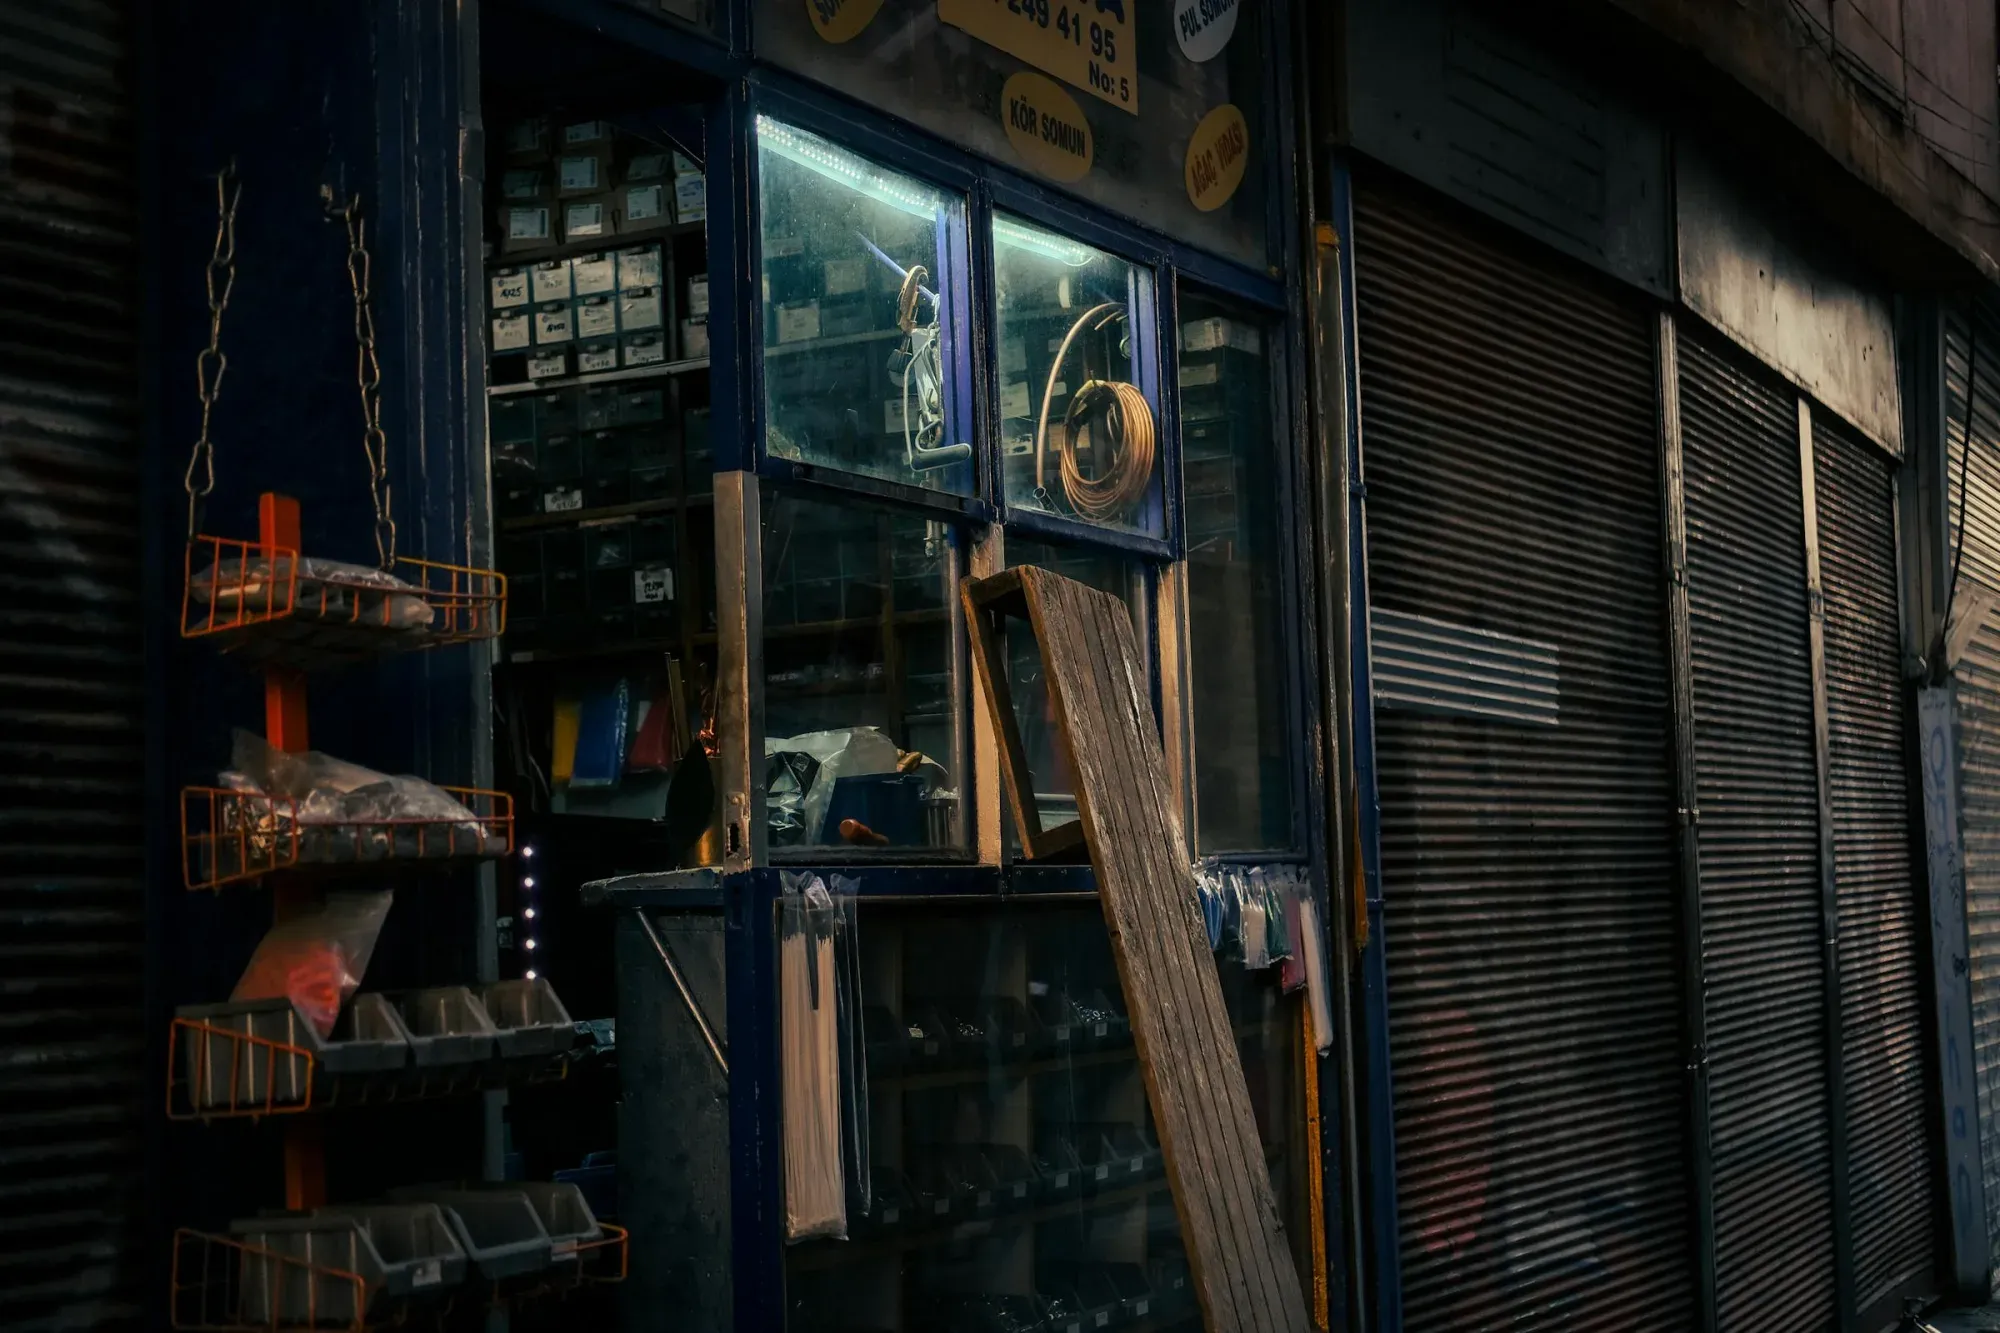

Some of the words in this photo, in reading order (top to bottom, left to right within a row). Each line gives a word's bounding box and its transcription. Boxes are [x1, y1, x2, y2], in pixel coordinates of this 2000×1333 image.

[1057, 5, 1080, 45] 41
[1091, 21, 1117, 62] 95
[1180, 6, 1202, 41] PUL
[1089, 60, 1115, 96] No:
[1120, 77, 1130, 102] 5
[1011, 94, 1038, 137] KÖR
[1042, 112, 1086, 158] SOMUN
